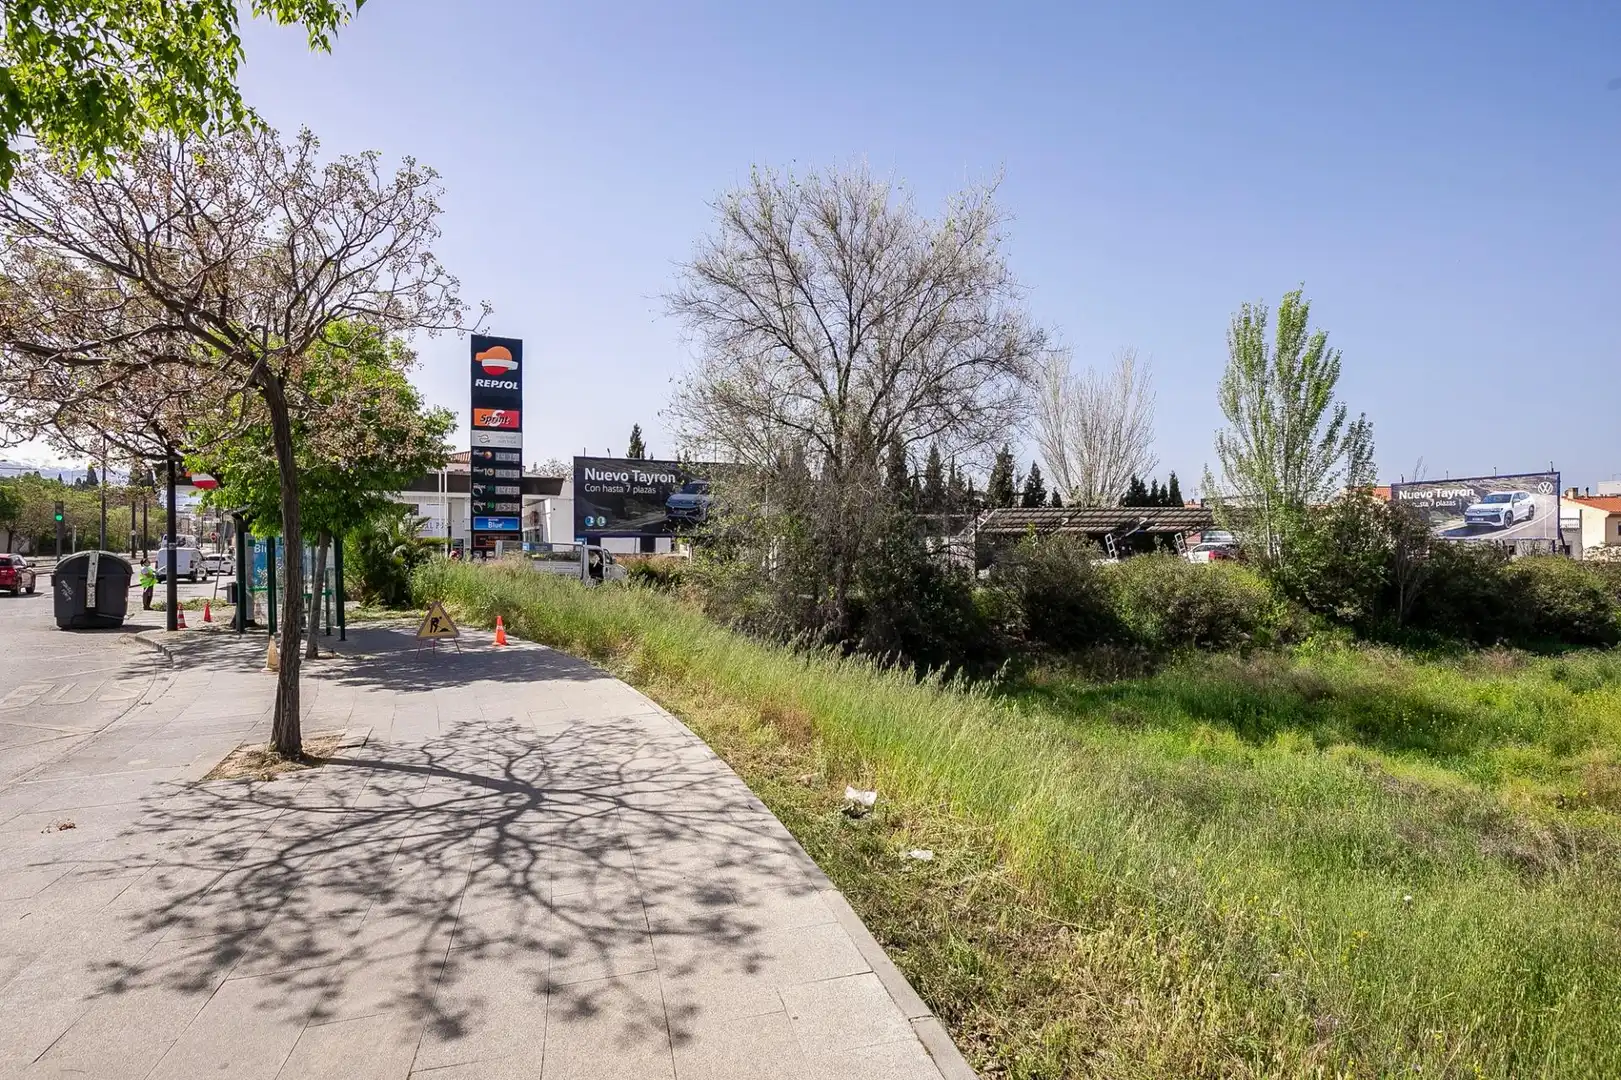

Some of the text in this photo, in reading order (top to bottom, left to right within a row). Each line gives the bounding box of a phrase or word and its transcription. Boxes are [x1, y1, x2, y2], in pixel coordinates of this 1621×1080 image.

[475, 379, 519, 390] REPSOL
[480, 412, 512, 426] Sprint
[584, 467, 676, 485] Nuevo Tayron
[584, 483, 657, 495] Con hasta 7 plazas
[1399, 488, 1475, 500] Nuevo Tayron
[1435, 500, 1457, 508] plazas
